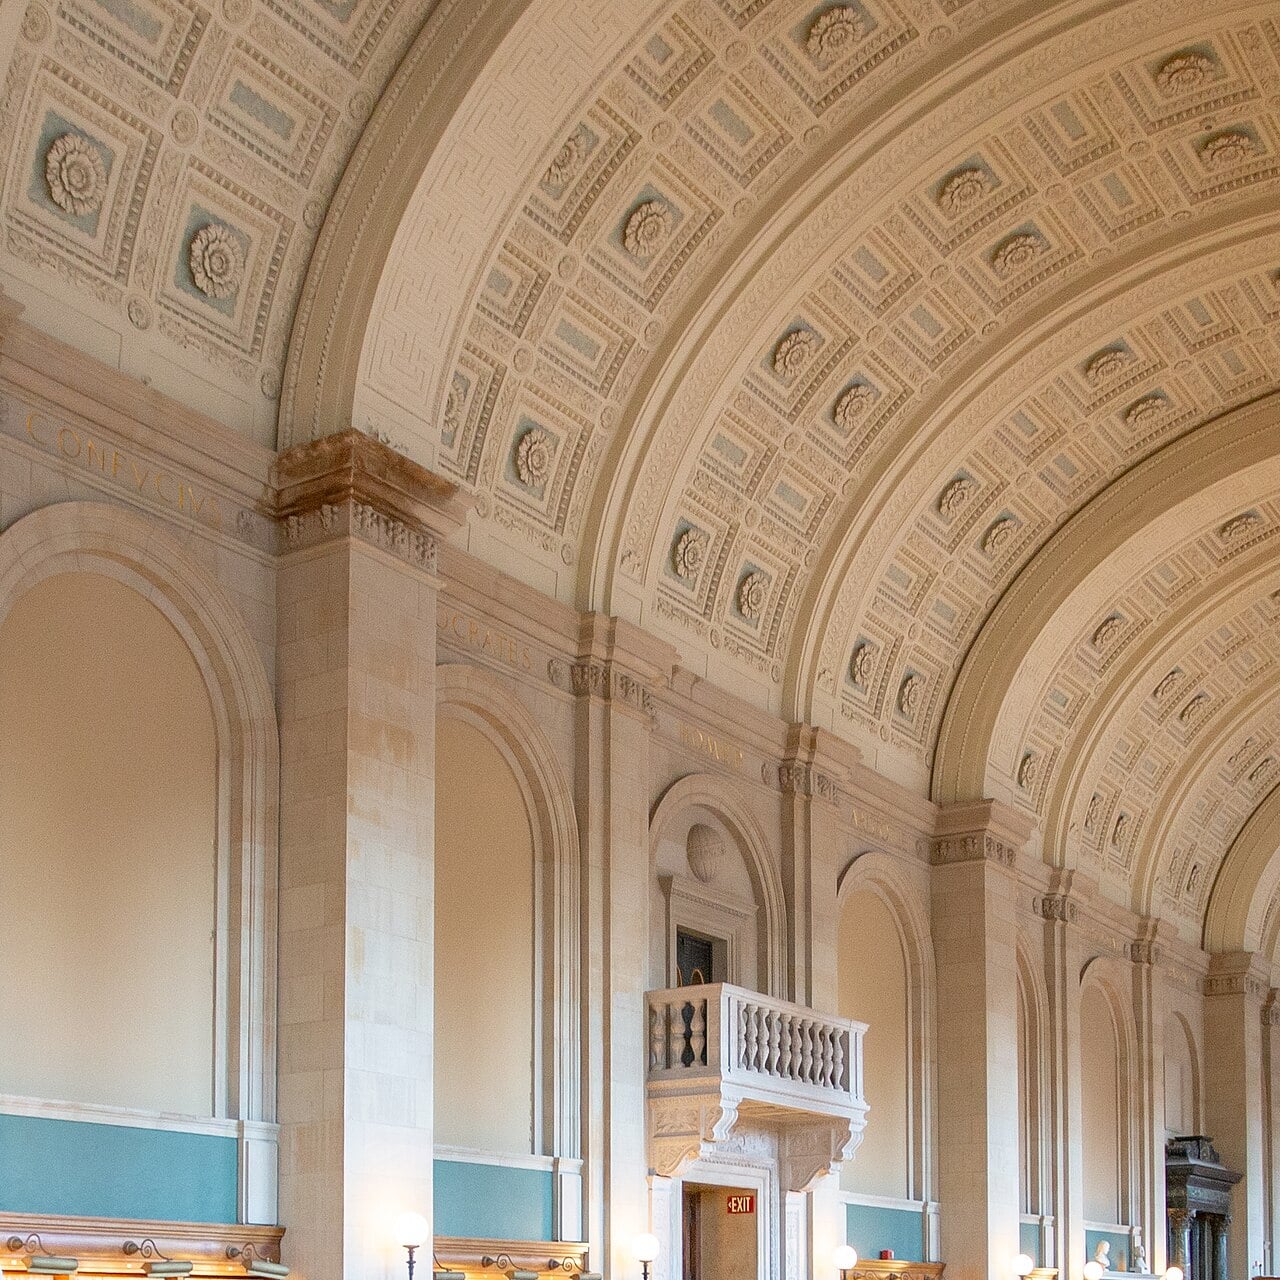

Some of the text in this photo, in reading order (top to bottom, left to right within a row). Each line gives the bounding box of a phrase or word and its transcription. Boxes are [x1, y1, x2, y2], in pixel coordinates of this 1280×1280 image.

[26, 412, 222, 528] CONFVCIVS
[436, 606, 532, 669] OCRATES
[731, 1196, 751, 1212] EXIT
